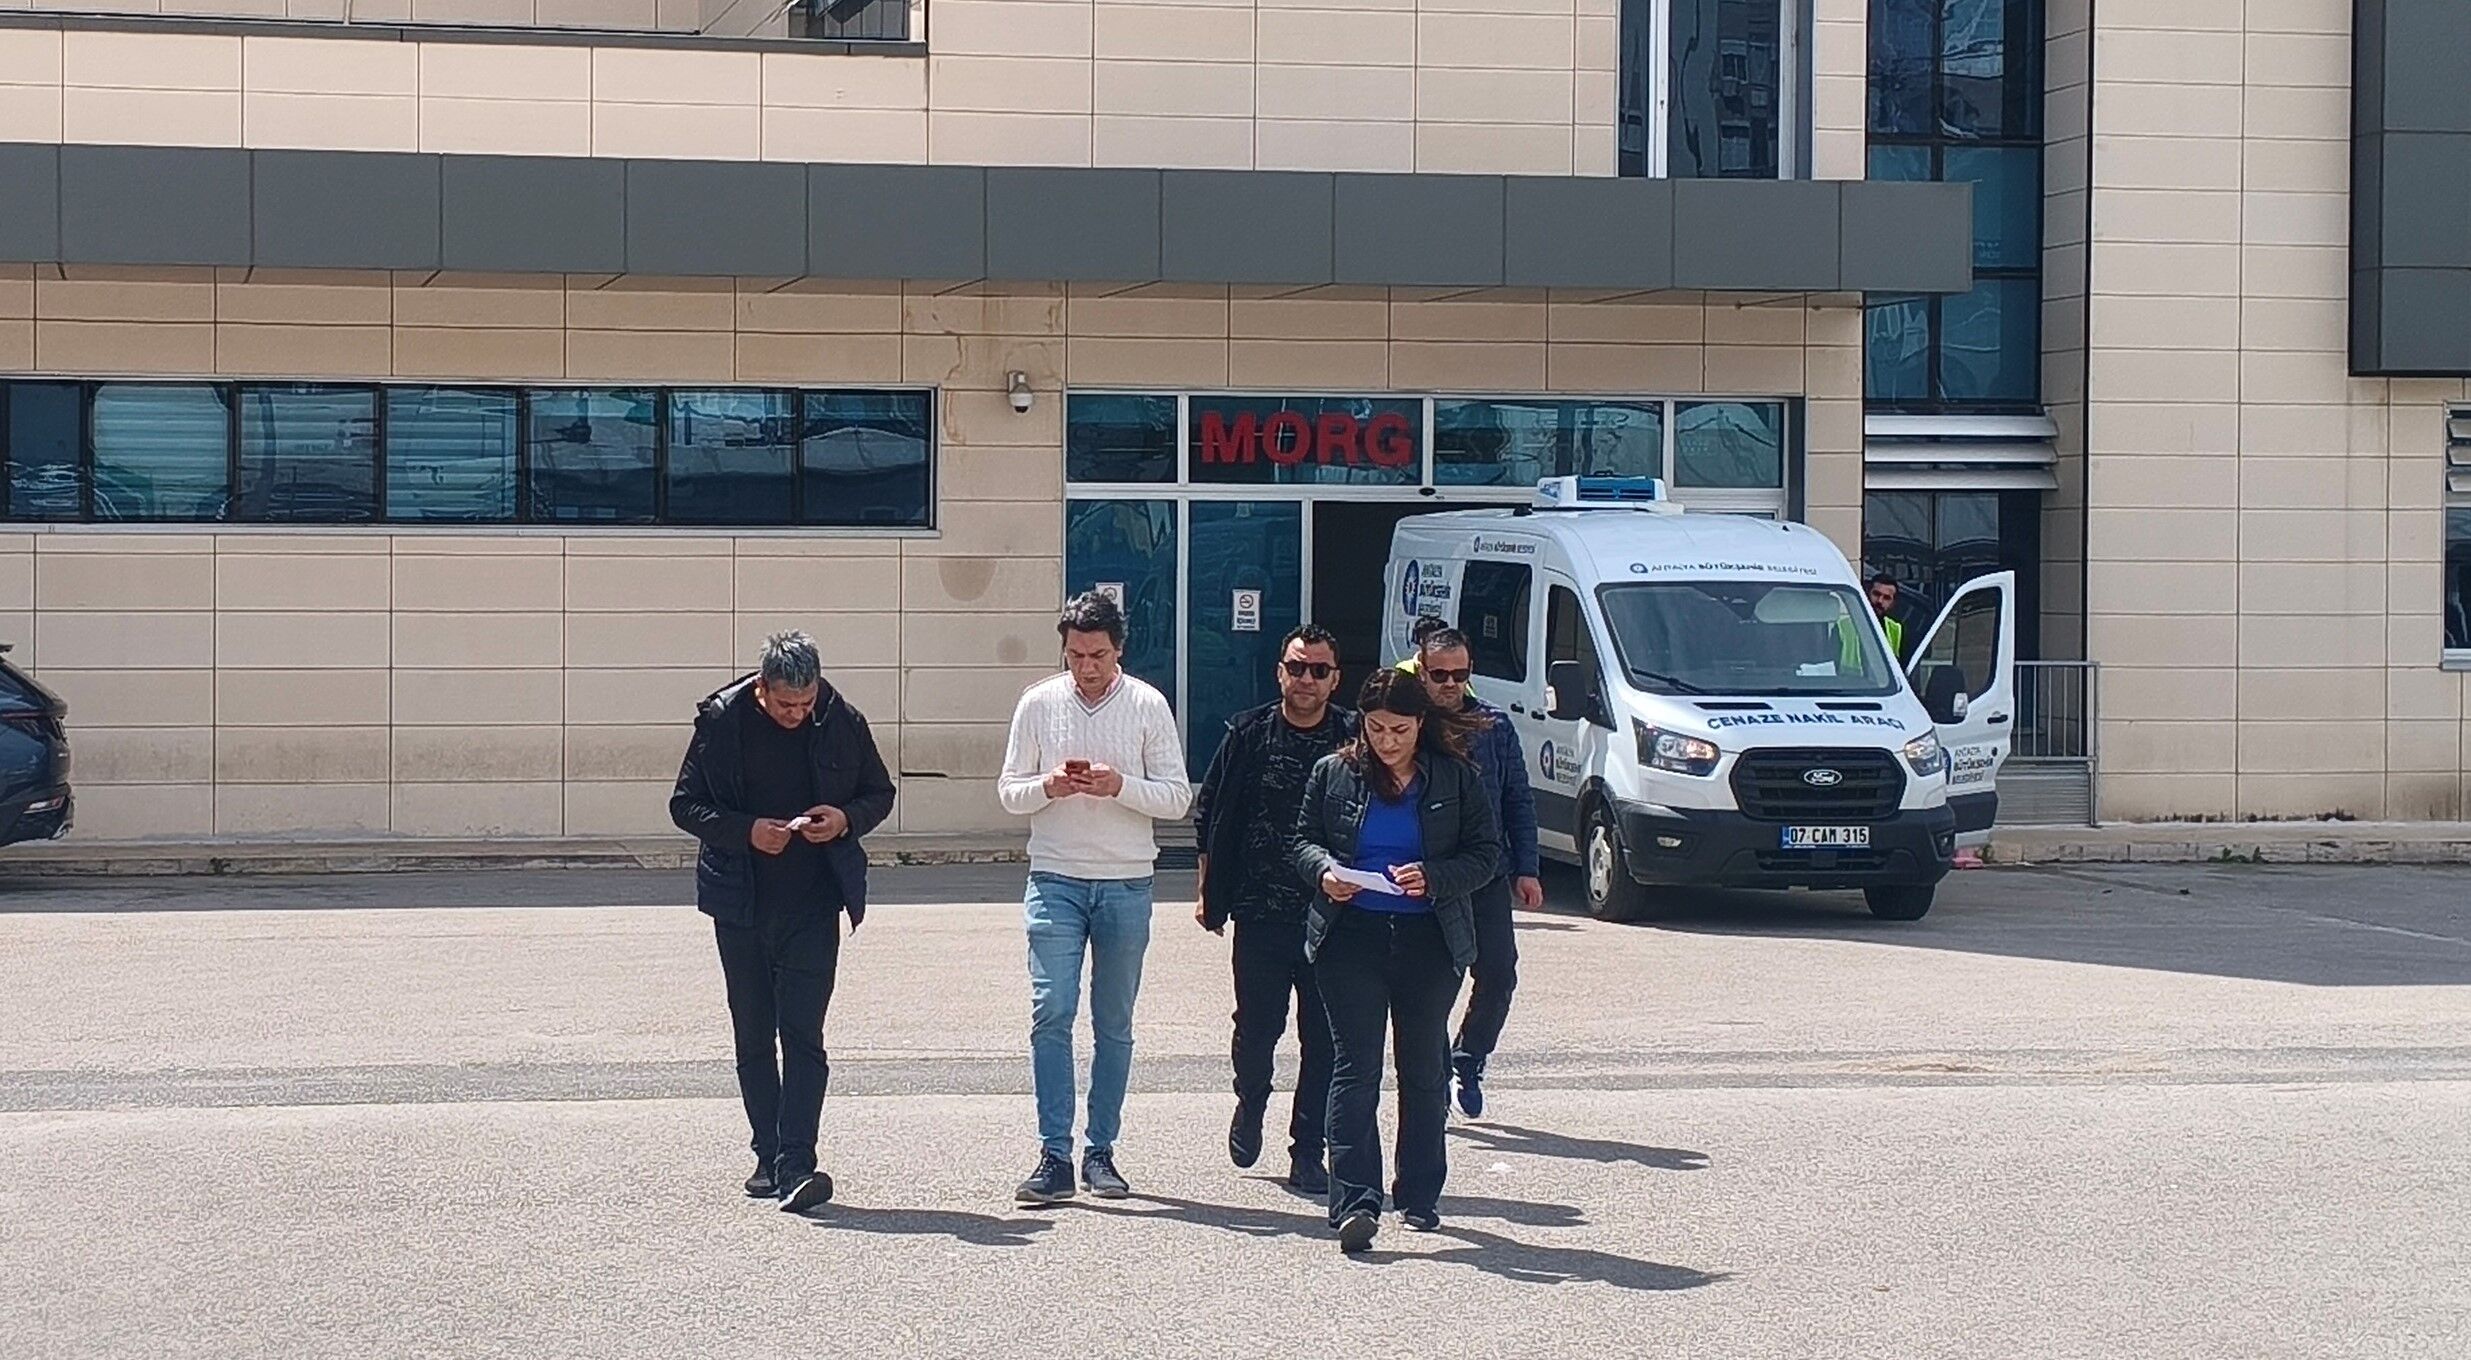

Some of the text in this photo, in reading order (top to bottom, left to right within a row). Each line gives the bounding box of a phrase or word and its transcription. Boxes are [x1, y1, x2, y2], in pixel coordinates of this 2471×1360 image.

[1201, 410, 1414, 468] MORG
[1707, 714, 1785, 730] CENAZE
[1785, 711, 1845, 724] NAKİL
[1790, 827, 1807, 843] 07
[1812, 827, 1837, 843] CAM
[1842, 827, 1867, 843] 315
